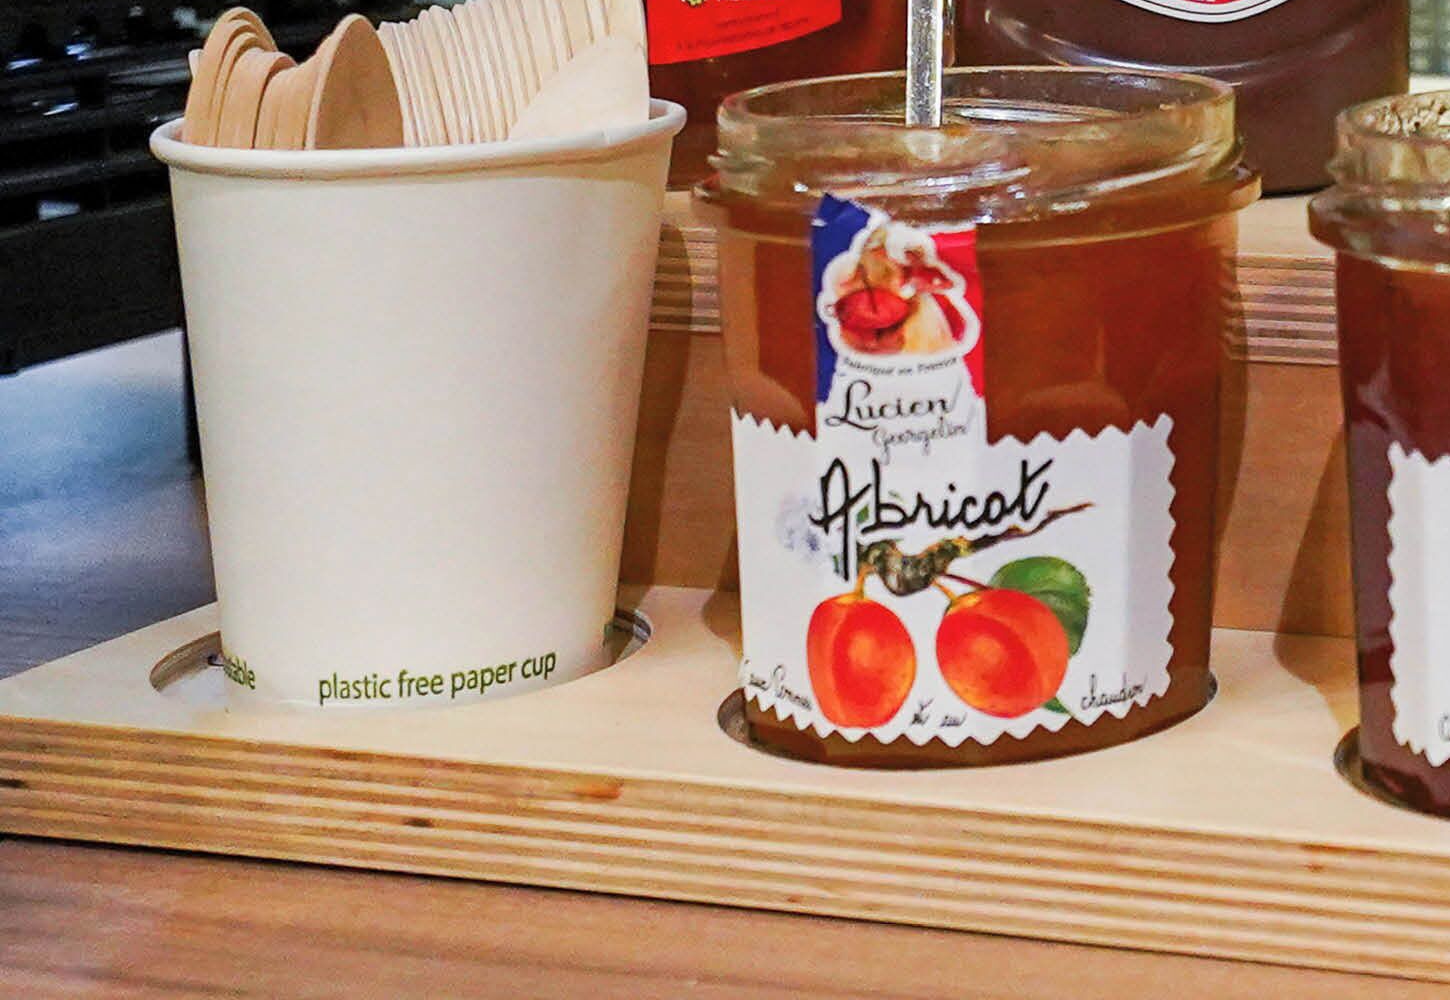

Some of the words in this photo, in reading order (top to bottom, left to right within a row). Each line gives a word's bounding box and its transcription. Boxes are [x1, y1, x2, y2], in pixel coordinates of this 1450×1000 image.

[825, 379, 962, 430] Lucien
[808, 457, 1053, 581] Abricot
[319, 672, 392, 706] plastic
[397, 668, 444, 698] free
[451, 659, 517, 698] paper
[522, 652, 557, 680] cup
